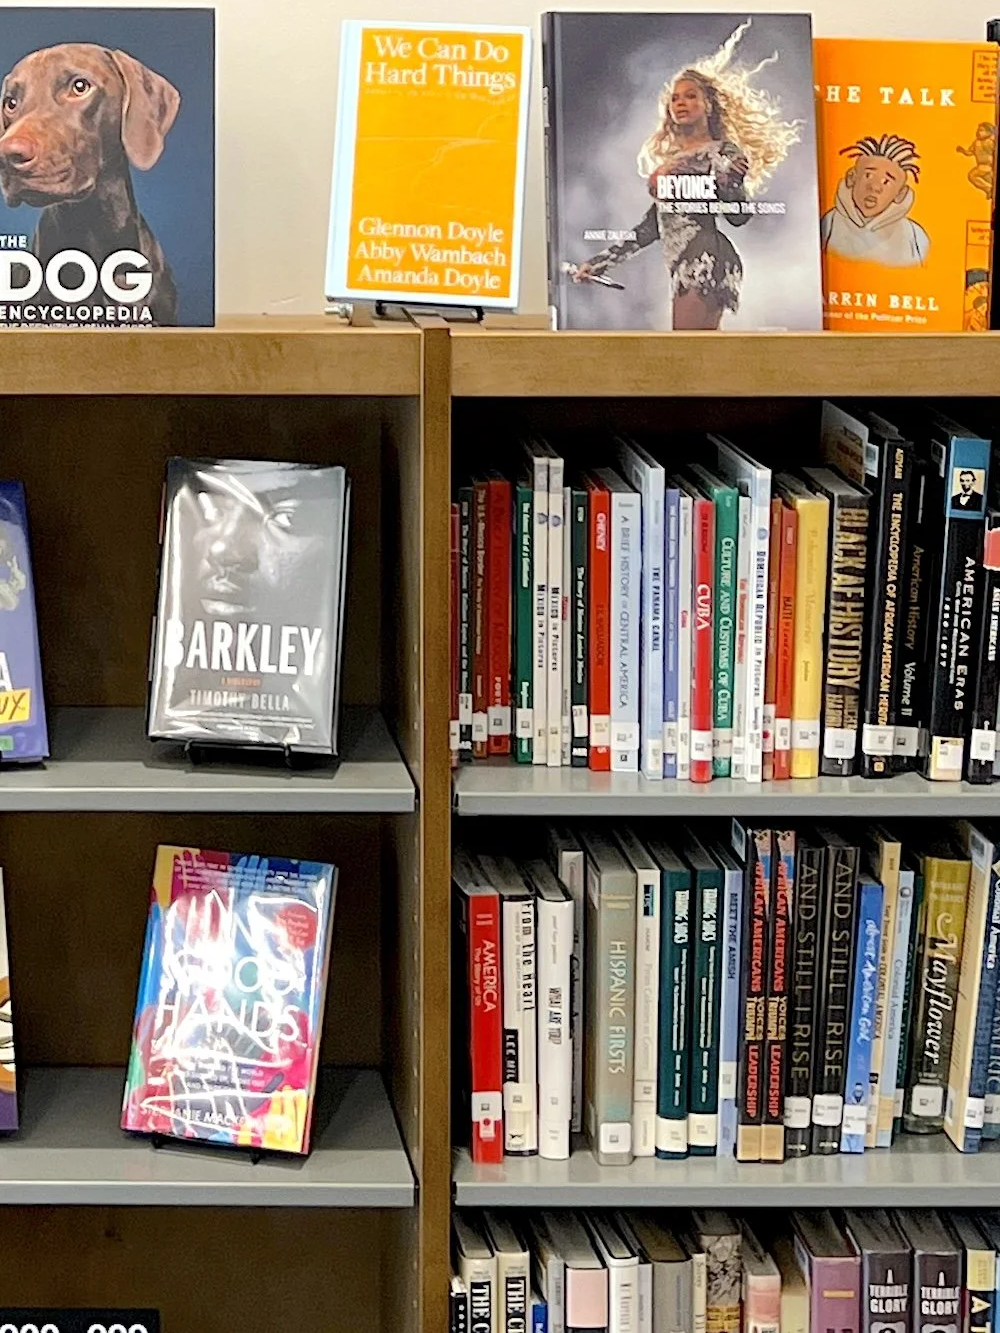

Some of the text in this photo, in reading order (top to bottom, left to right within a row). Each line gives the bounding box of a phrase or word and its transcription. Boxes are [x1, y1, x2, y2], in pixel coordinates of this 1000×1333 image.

[374, 35, 509, 62] We Can Do
[365, 62, 515, 95] Hard Things
[879, 87, 956, 107] TALK
[358, 217, 504, 247] Glennon Doyle
[659, 202, 673, 213] THE
[674, 202, 708, 214] STORIES
[741, 202, 756, 214] THE
[757, 202, 786, 215] SONGS
[356, 241, 506, 267] Abby Wambach
[357, 264, 500, 293] Amanda Doyle
[823, 291, 939, 311] RRIN BELL
[619, 516, 630, 524] A
[892, 493, 904, 511] THE
[619, 528, 630, 553] BRIEF
[835, 508, 867, 568] BLACK
[886, 513, 902, 581] ENCYCLOPEDIA
[619, 556, 630, 599] HISTORY
[833, 571, 863, 600] AF
[886, 584, 897, 598] OF
[696, 584, 712, 631] CUBA
[717, 536, 735, 721] CULTURE AND CUSTOMS OF CUBA
[782, 596, 793, 620] HAITI
[901, 545, 925, 716] American History Volume II
[958, 556, 977, 657] AMERICAN
[164, 619, 322, 676] BARKLEY
[619, 611, 630, 660] CENTRAL
[826, 601, 862, 686] HISTORY
[880, 600, 896, 692] AFRICAN-AMERICAN
[190, 689, 290, 711] TIMOTHY BELLA
[619, 661, 630, 709] AMERICA
[954, 665, 969, 711] ERAS
[797, 864, 818, 921] AND
[833, 862, 853, 918] AND
[482, 939, 497, 1013] AMERICA
[751, 917, 764, 992] AMERICANS
[773, 917, 787, 992] AMERICANS
[794, 932, 815, 997] STILL
[829, 929, 850, 994] STILL
[608, 941, 627, 1074] HISPANIC FIRSTS
[921, 913, 958, 1064] Mayflower
[790, 1024, 810, 1079] RISE
[824, 1022, 845, 1077] RISE
[746, 1045, 759, 1117] LEADERSHIP
[768, 1045, 781, 1117] LEADERSHIP
[472, 1285, 490, 1318] THE
[507, 1279, 525, 1314] THE
[869, 1298, 908, 1314] GLORY
[920, 1299, 960, 1316] GLORY
